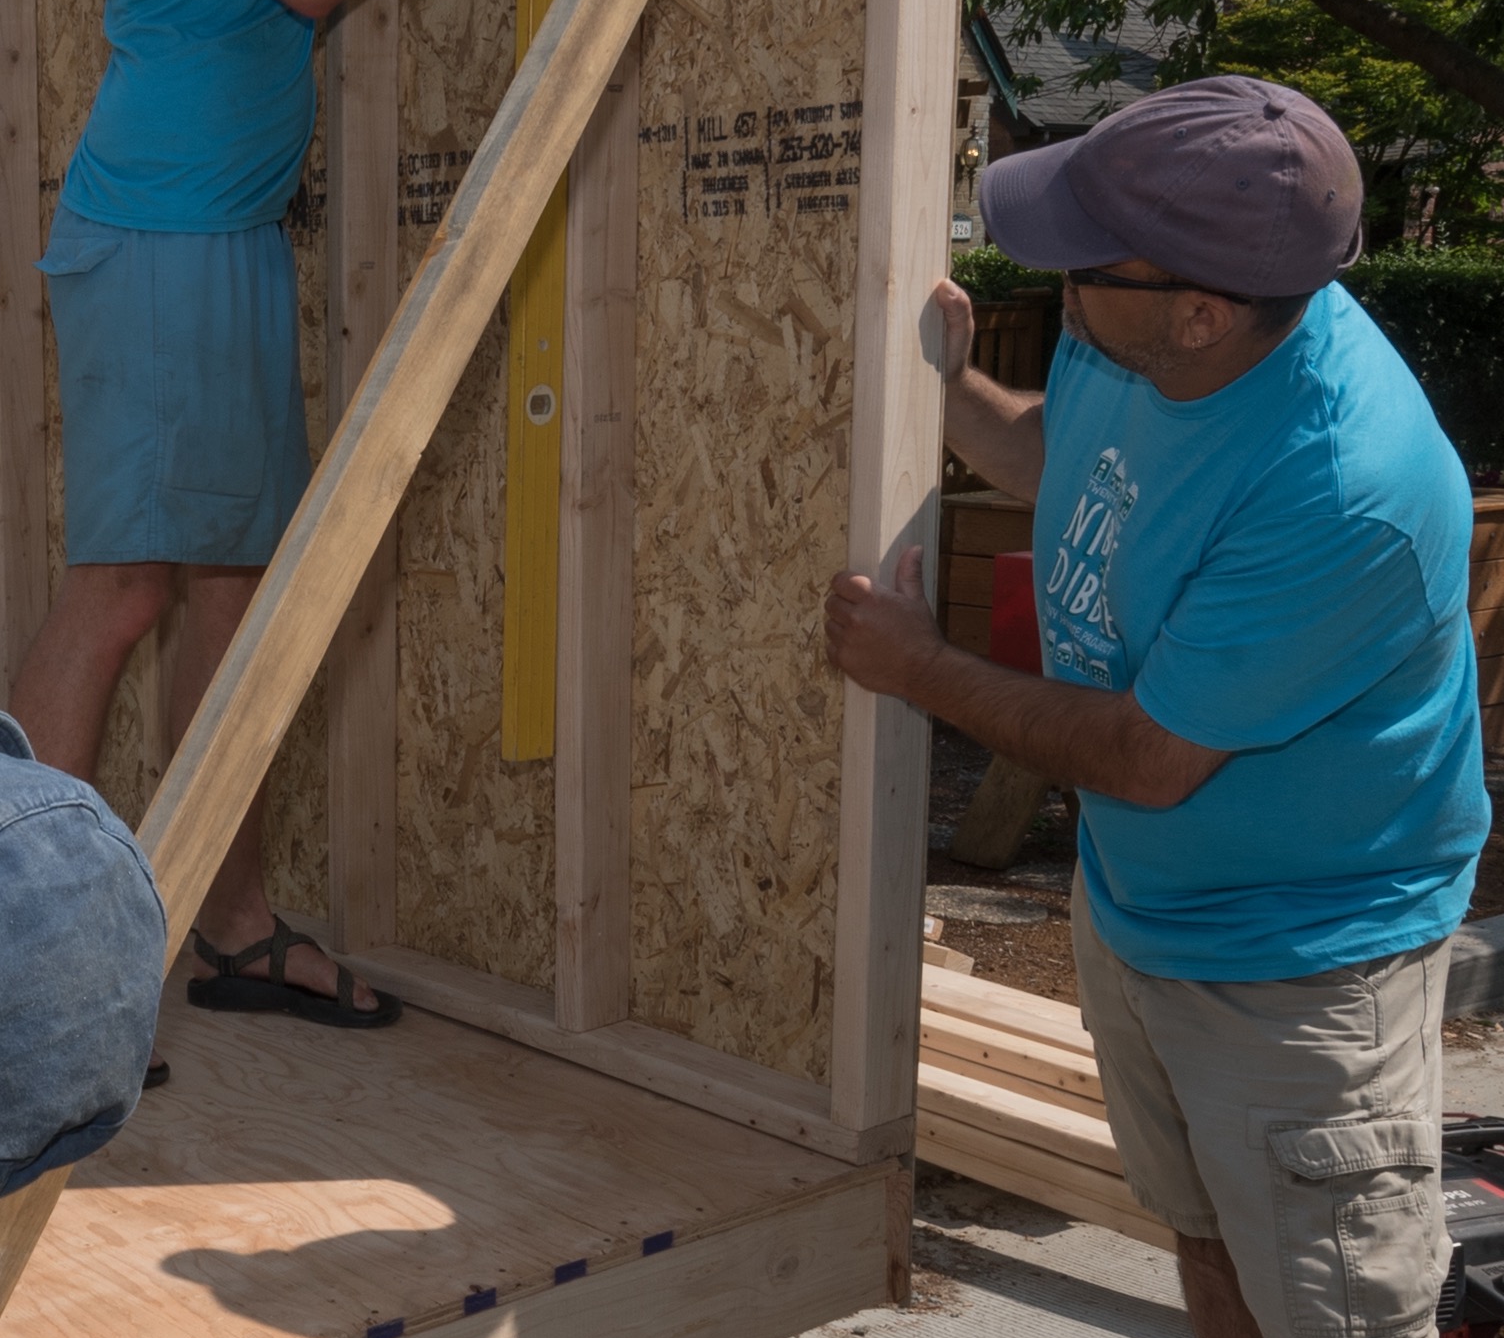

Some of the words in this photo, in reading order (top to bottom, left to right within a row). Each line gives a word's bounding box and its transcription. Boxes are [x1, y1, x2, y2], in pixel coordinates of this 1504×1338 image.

[794, 104, 833, 124] PRODUCT
[697, 115, 727, 143] MILL
[733, 111, 756, 139] 457
[732, 147, 765, 166] CANADA
[784, 170, 831, 189] STRENGTH
[835, 167, 860, 186] AXIS
[702, 200, 729, 217] 0.315
[951, 224, 969, 235] 526
[1086, 479, 1117, 505] TWENTY
[1079, 631, 1115, 657] PROJECT
